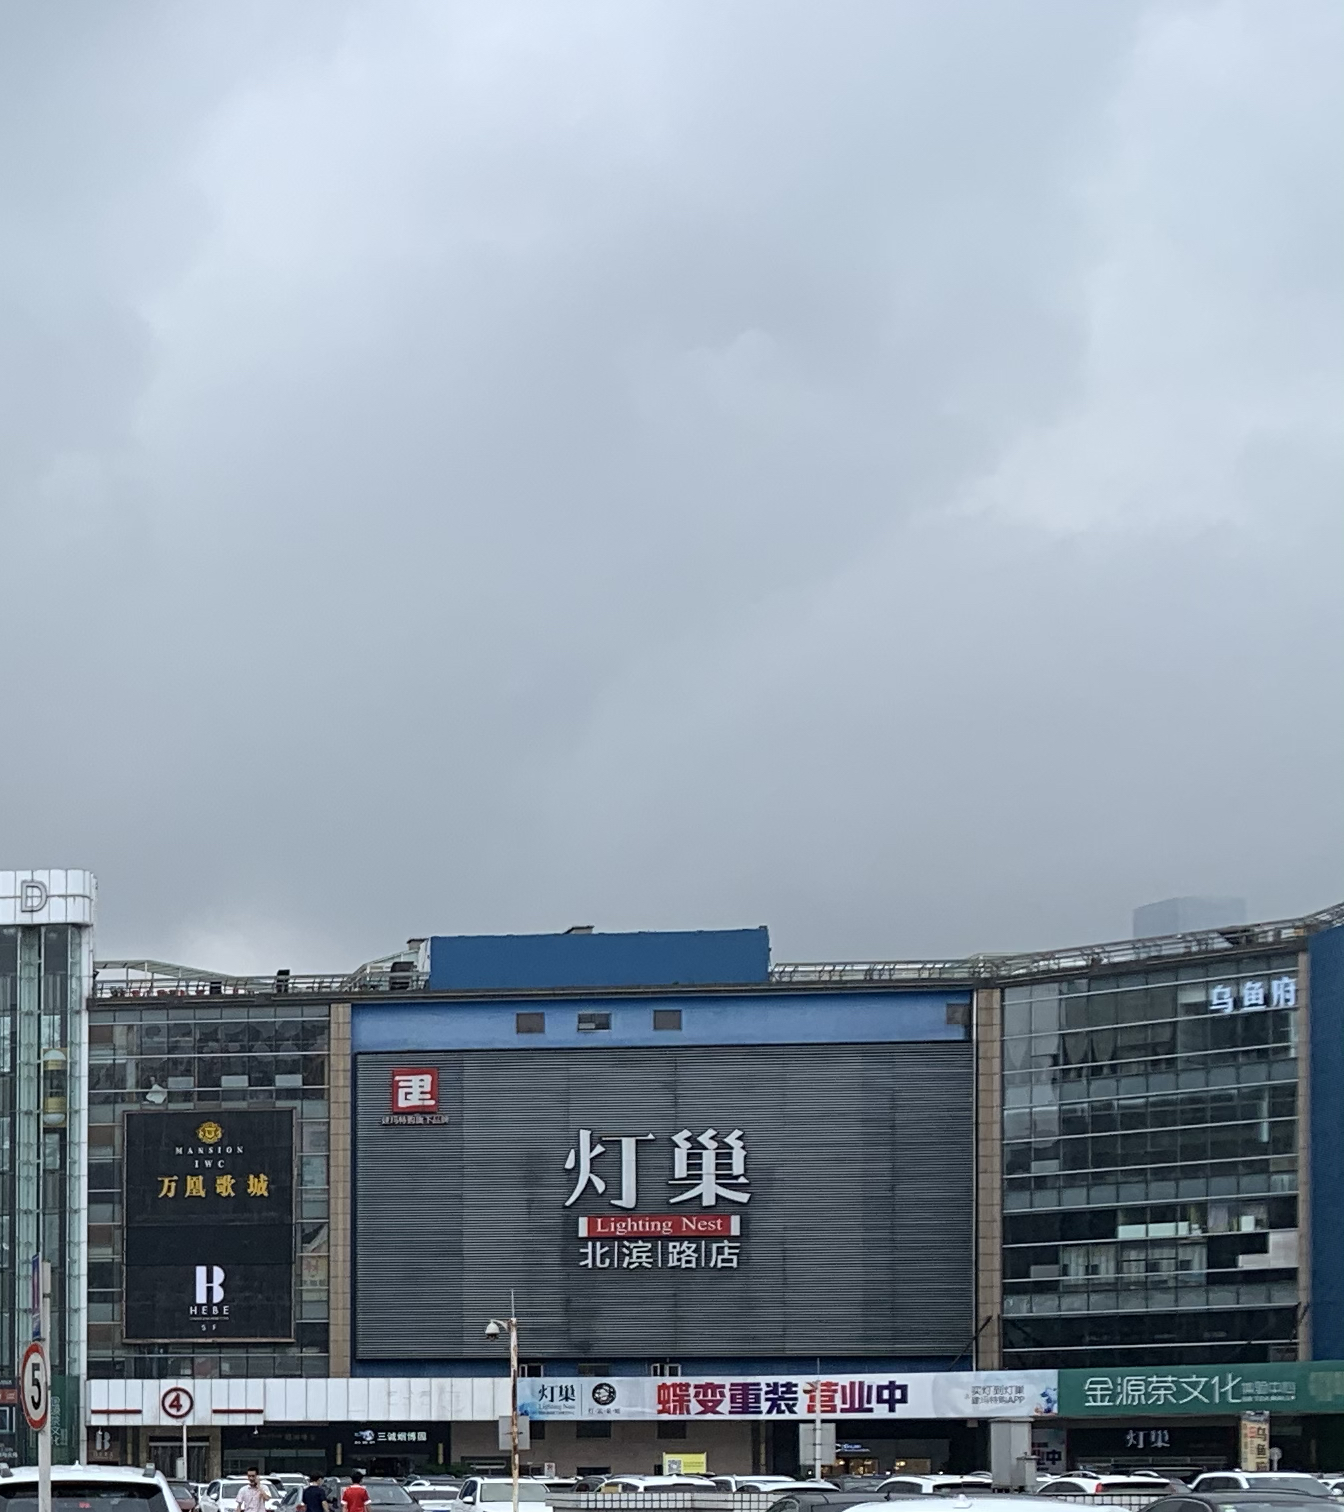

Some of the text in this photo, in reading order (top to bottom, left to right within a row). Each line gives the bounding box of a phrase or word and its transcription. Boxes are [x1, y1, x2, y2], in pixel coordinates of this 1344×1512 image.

[21, 881, 46, 912] D
[175, 1146, 244, 1155] MANSION
[194, 1160, 224, 1169] IWC
[564, 1128, 752, 1209] 灯巢
[157, 1173, 269, 1198] 万凰歌城
[596, 1217, 723, 1235] Lighting Nest
[189, 1305, 230, 1315] HEBE
[31, 1362, 42, 1411] 5
[538, 1384, 576, 1402] 灯巢
[1125, 1428, 1171, 1449] 灯巢
